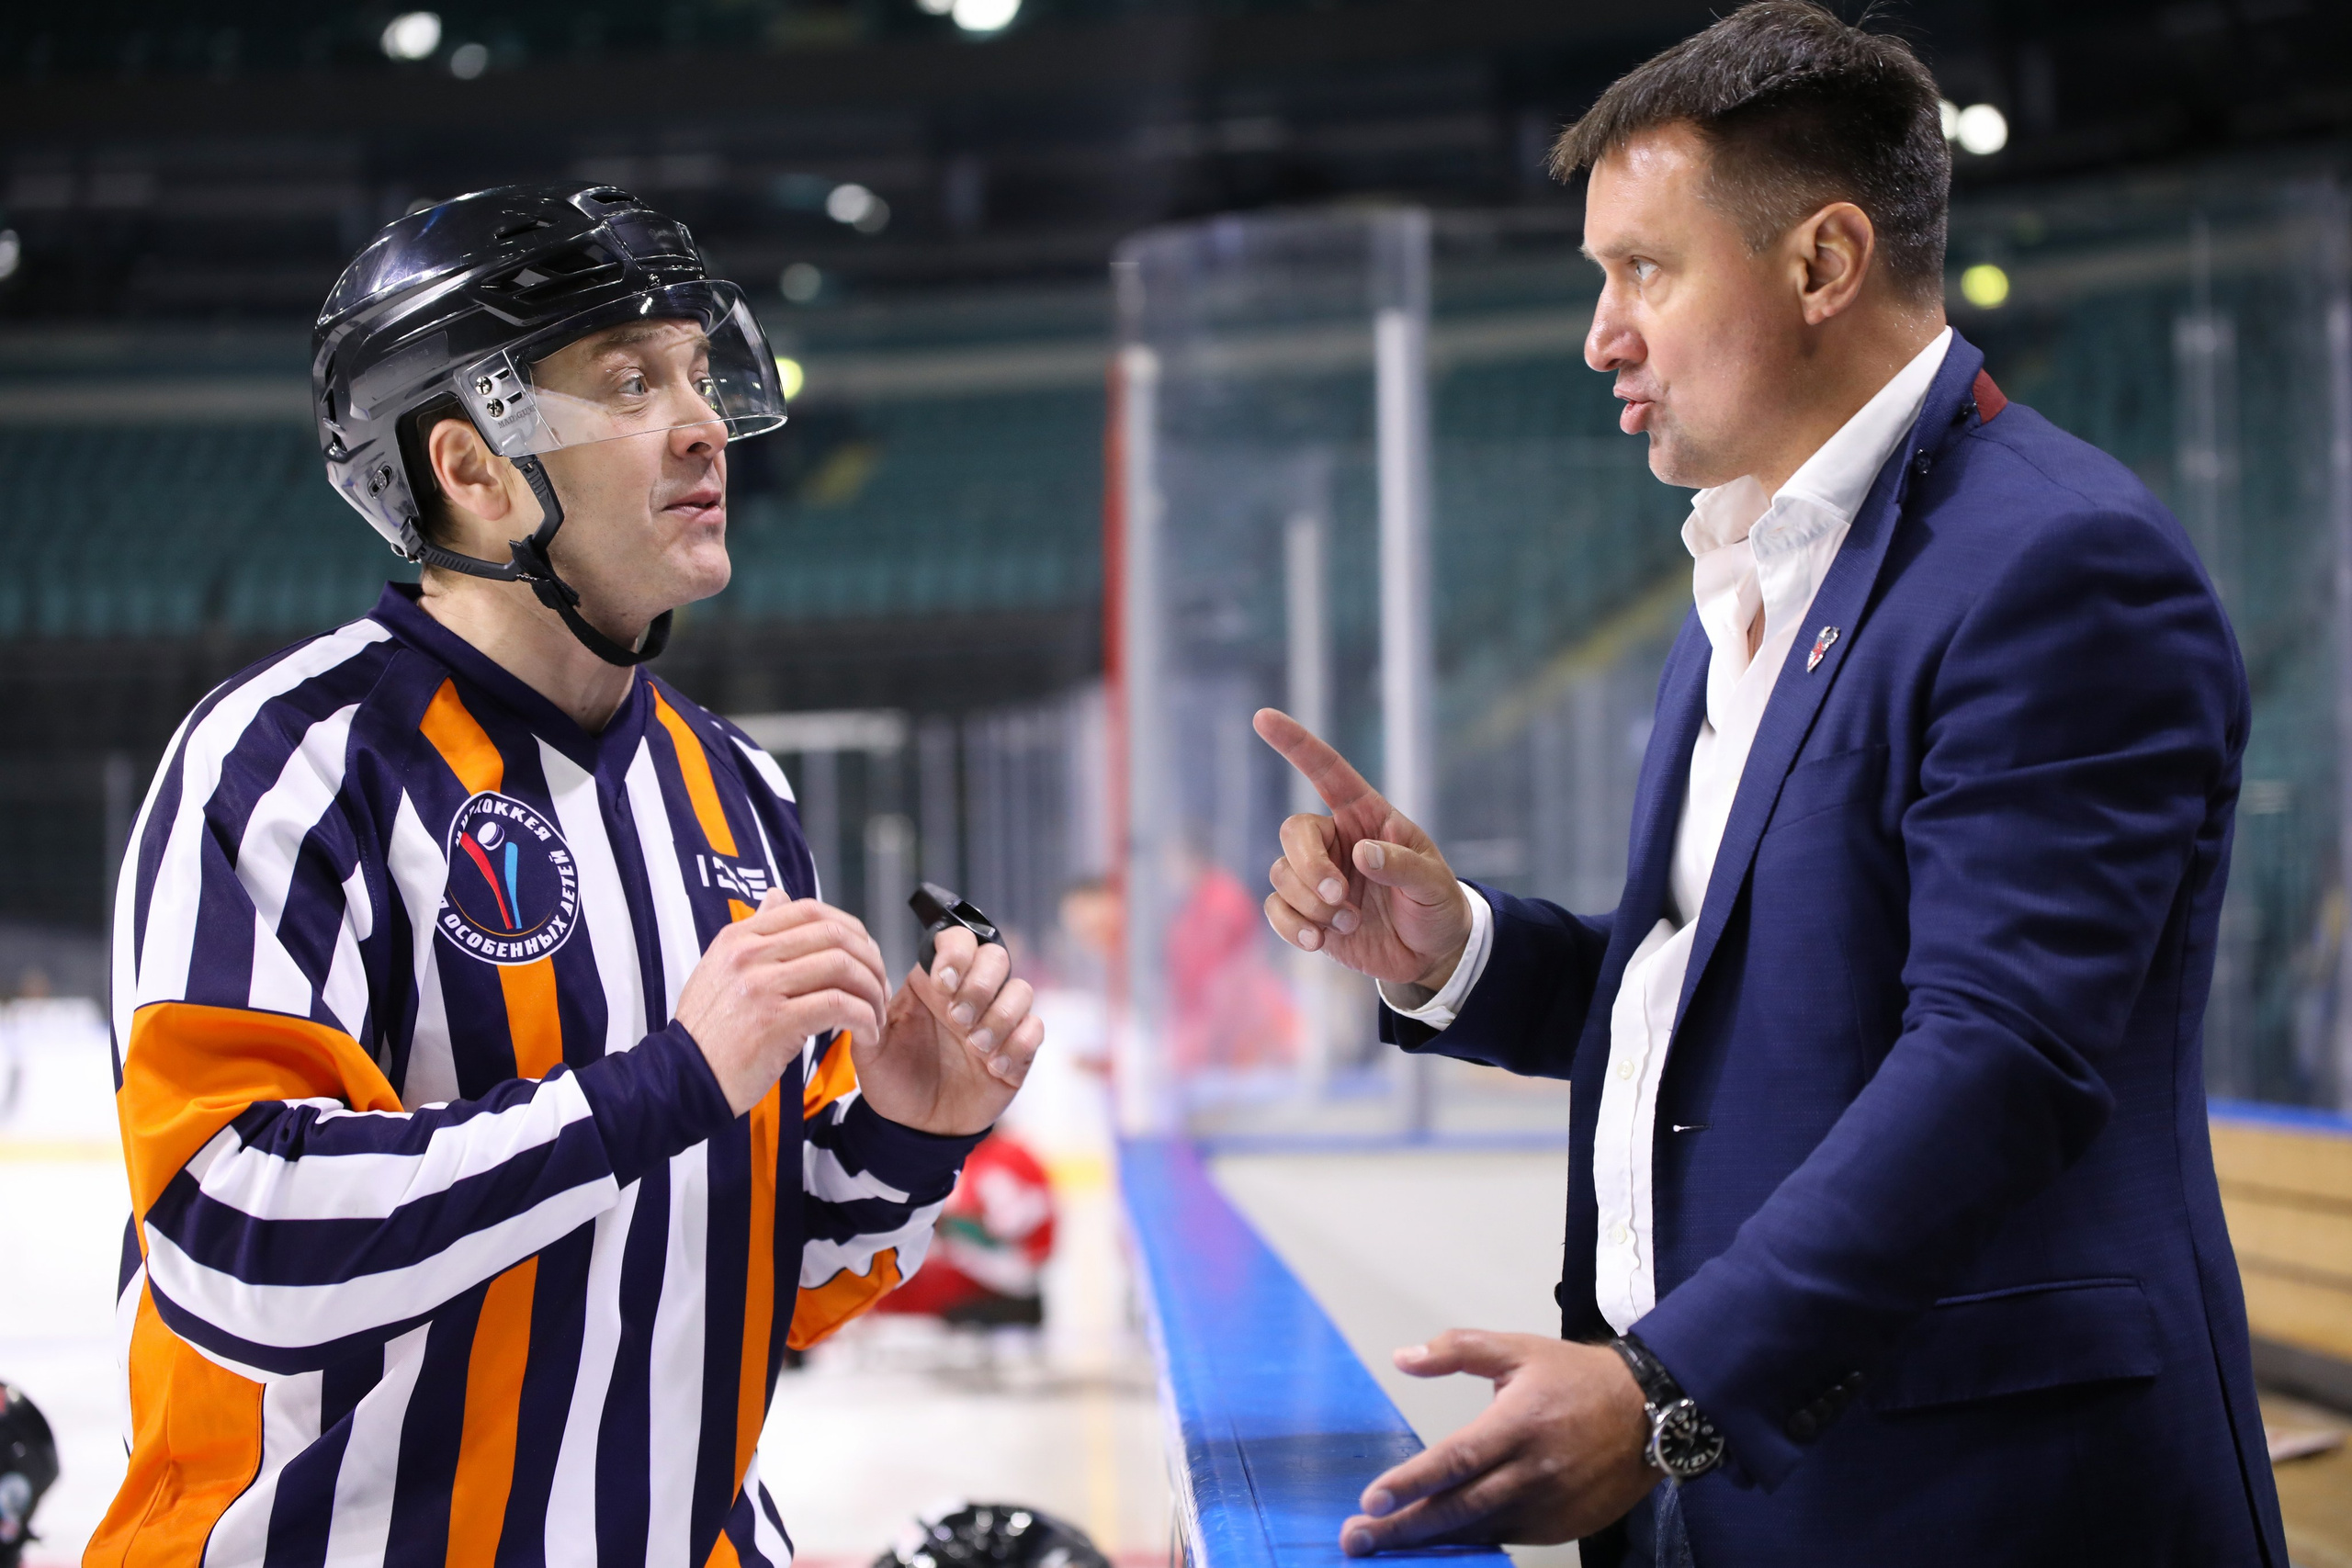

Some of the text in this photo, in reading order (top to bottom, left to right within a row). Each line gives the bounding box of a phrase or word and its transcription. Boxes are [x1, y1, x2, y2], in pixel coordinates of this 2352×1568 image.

[473, 798, 551, 841] ХОККЕЯ
[444, 850, 576, 958] ОСОБЕННЫХ ДЕТЕЙ
